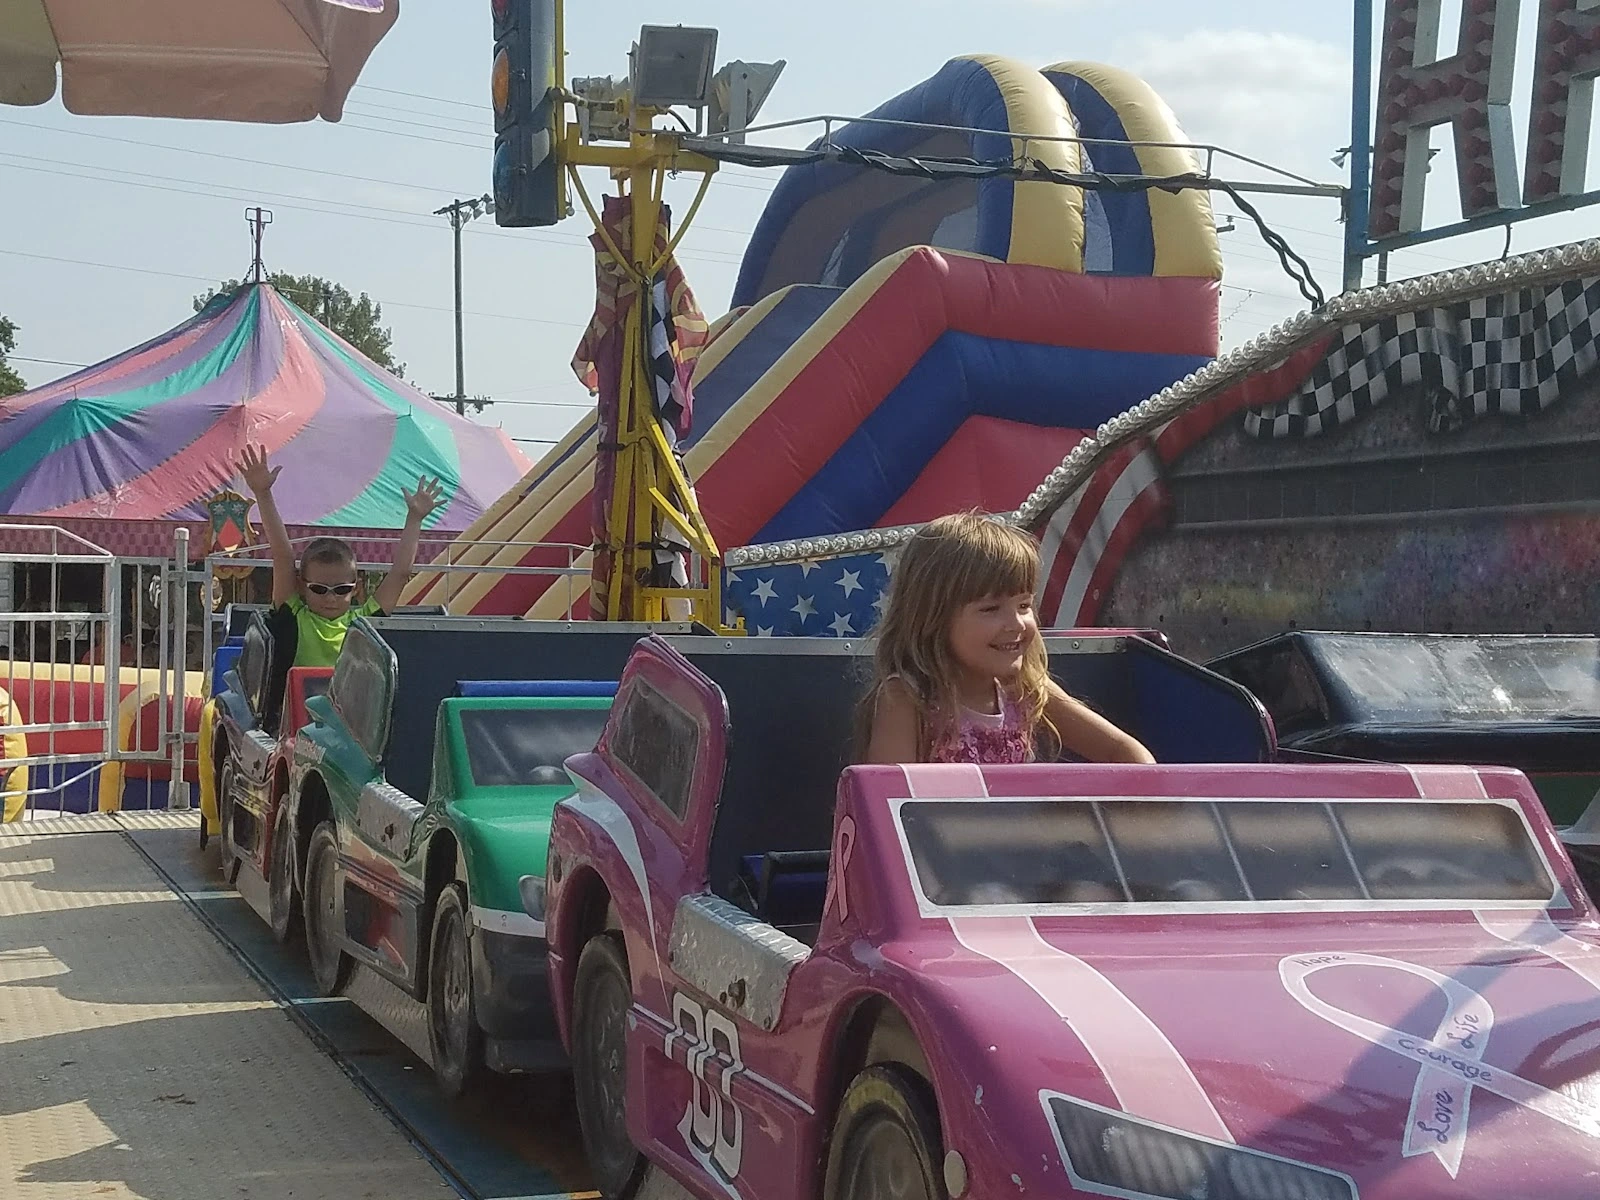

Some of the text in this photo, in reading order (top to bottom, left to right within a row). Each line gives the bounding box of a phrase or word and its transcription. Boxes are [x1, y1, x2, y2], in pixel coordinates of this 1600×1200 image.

[1446, 1014, 1479, 1049] Life
[1398, 1039, 1492, 1082] Courage
[1417, 1090, 1454, 1144] Love
